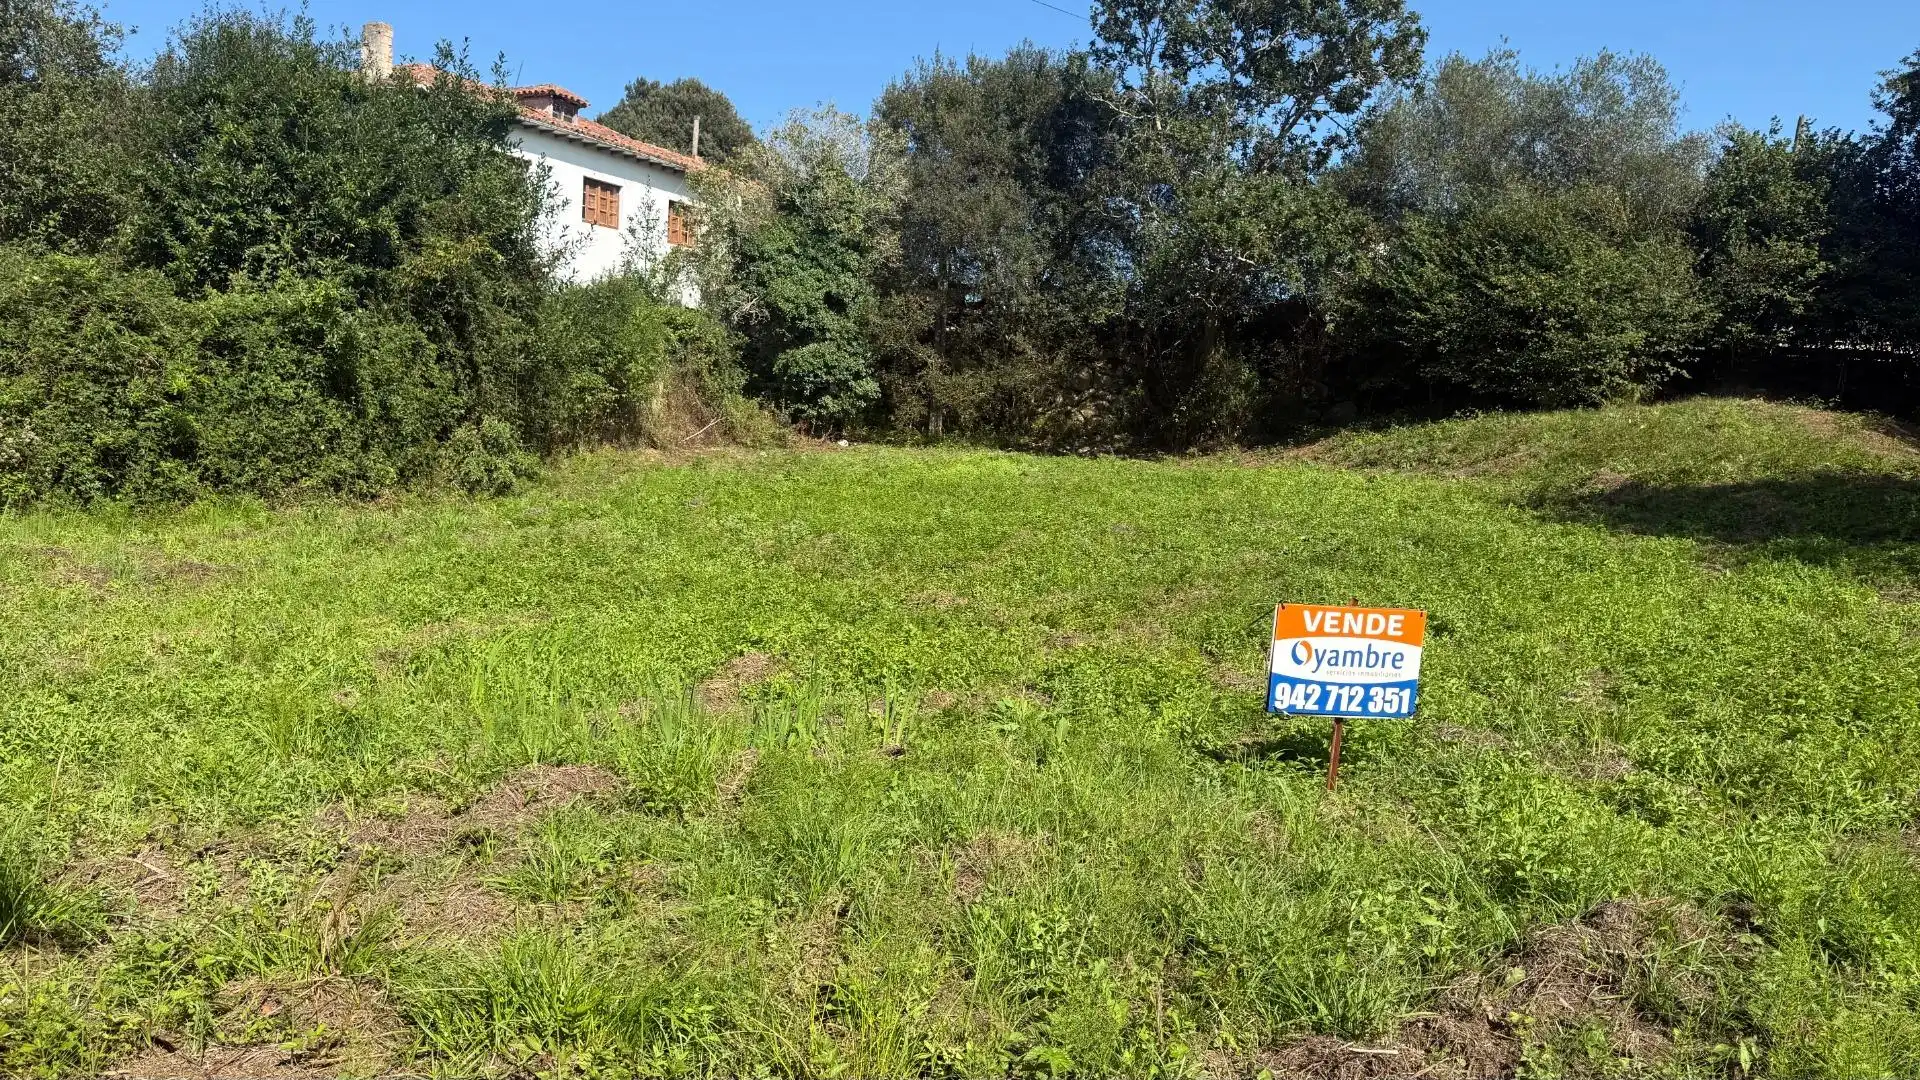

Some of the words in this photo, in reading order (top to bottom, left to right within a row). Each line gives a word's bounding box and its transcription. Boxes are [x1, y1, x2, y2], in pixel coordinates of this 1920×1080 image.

[1303, 610, 1404, 636] VENDE
[1291, 640, 1404, 673] Oyambre
[1274, 682, 1321, 710] 942
[1325, 685, 1364, 712] 712
[1368, 687, 1410, 714] 351
